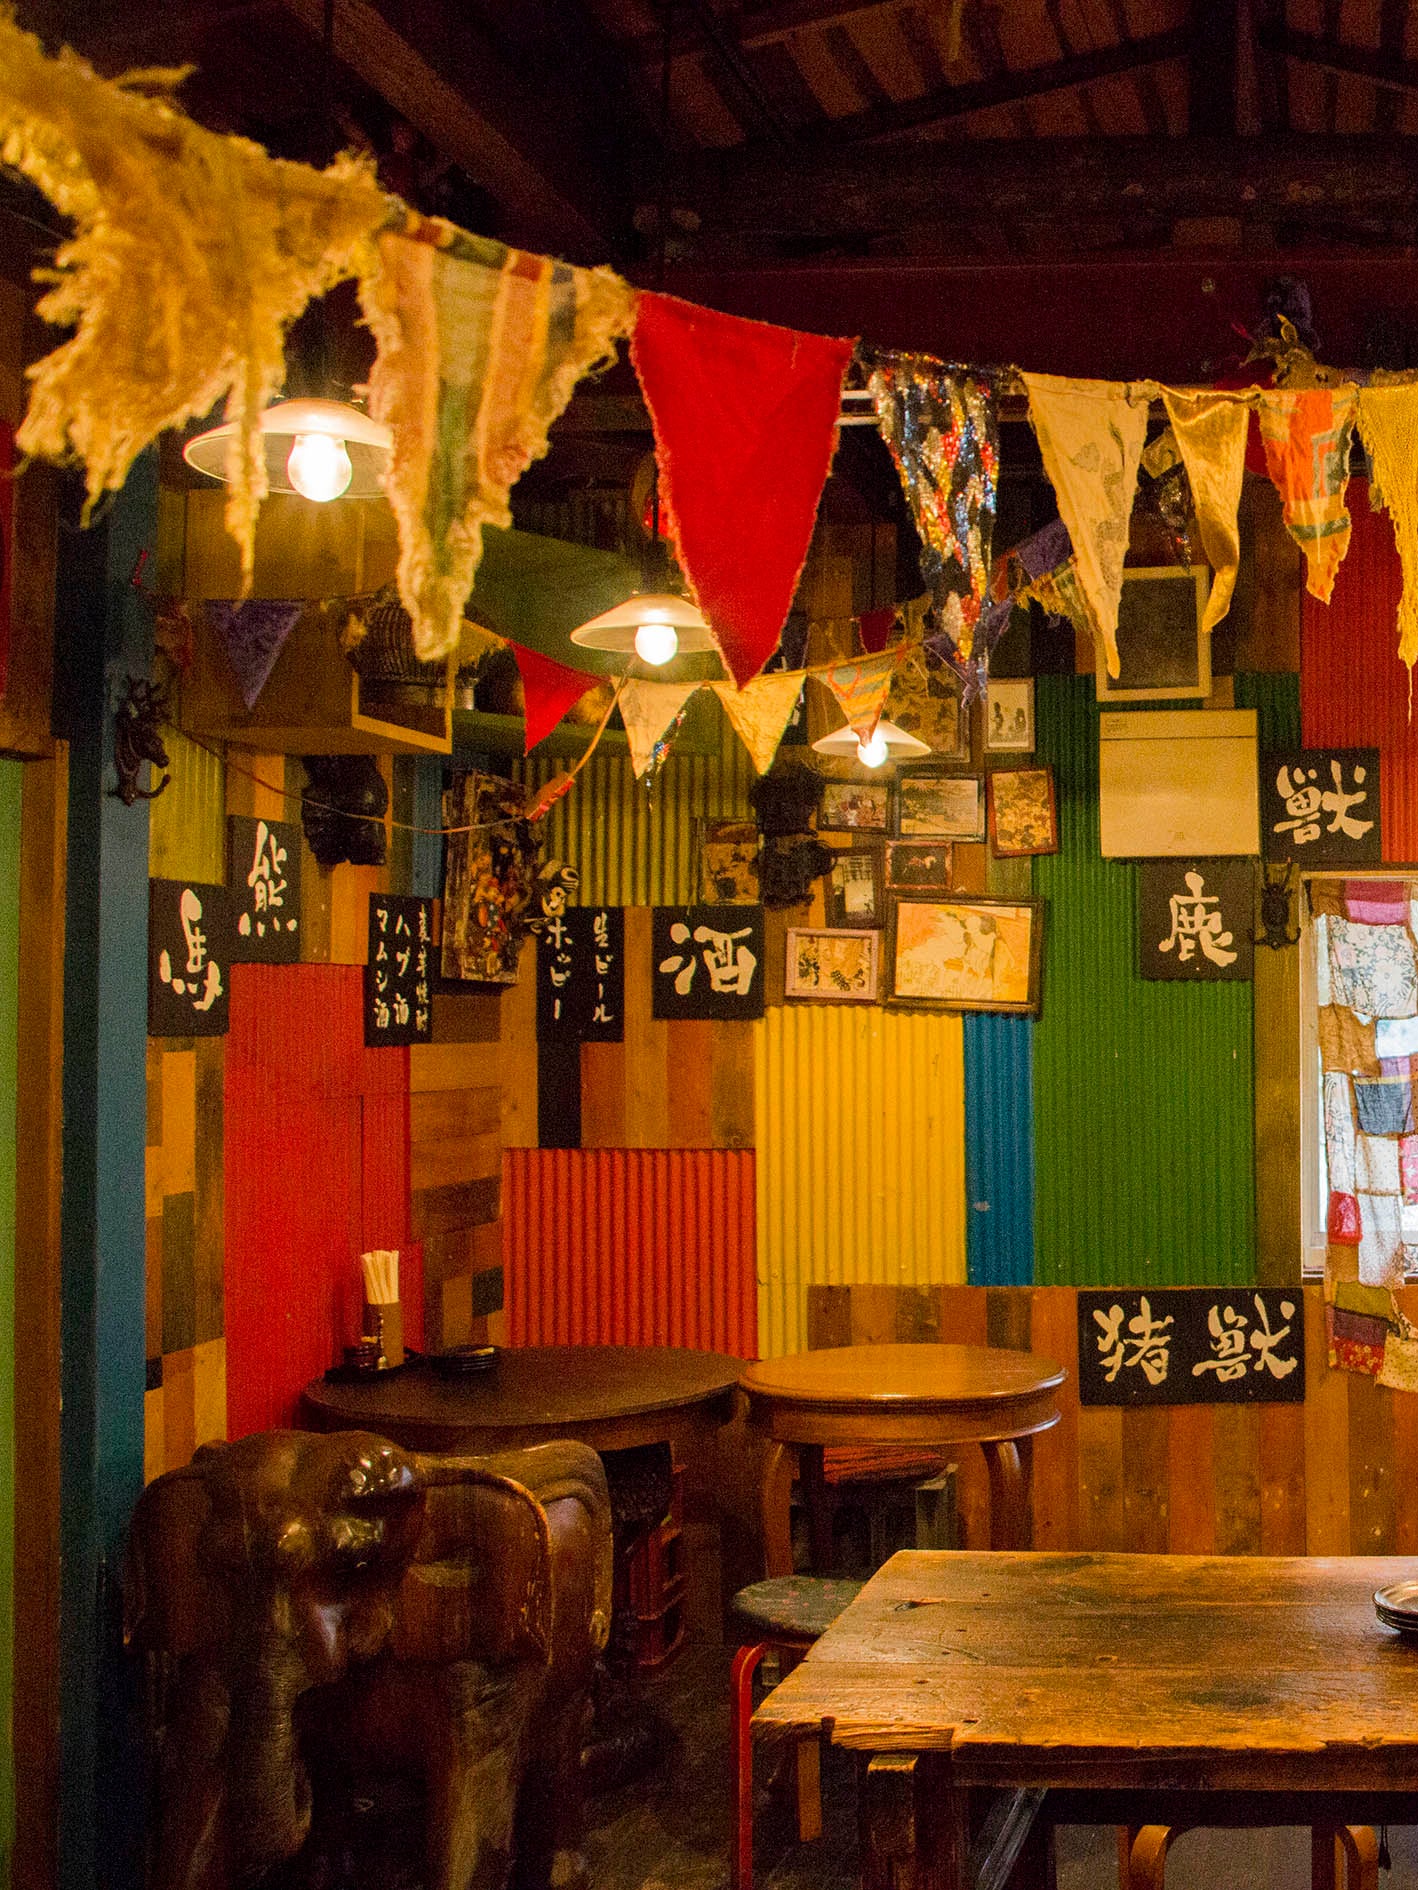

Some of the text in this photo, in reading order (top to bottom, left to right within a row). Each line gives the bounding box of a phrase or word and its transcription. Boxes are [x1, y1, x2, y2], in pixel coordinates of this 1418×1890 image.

[1273, 759, 1375, 845] 獣
[238, 820, 298, 938] 熊
[1158, 871, 1238, 968] 鹿
[159, 888, 224, 1012] 馬
[393, 913, 412, 1026] ハブ酒
[545, 916, 574, 1021] ホッピー
[592, 911, 615, 1024] 生ビール
[658, 922, 758, 996] 酒
